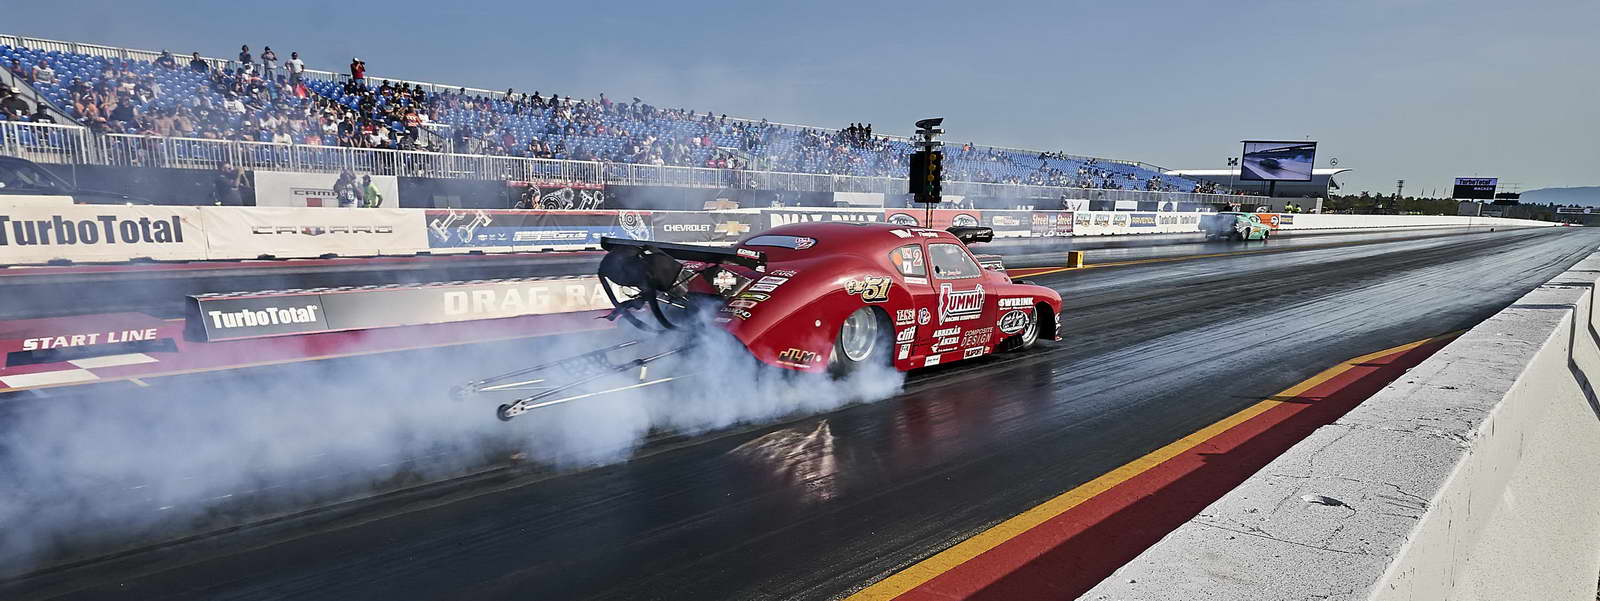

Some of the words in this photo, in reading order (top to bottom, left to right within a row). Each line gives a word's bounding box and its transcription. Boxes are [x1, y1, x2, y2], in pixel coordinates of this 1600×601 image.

[1032, 214, 1049, 225] Street
[1057, 214, 1073, 225] Street
[0, 215, 183, 246] TurboTotal
[663, 224, 711, 232] CHEVROLET
[444, 285, 549, 315] DRAG
[938, 283, 985, 325] SUMMIT
[209, 306, 317, 329] TurboTotal
[896, 326, 916, 341] cliff
[965, 327, 994, 337] COMPOSITE
[22, 333, 100, 351] START
[107, 329, 157, 344] LINE
[960, 333, 993, 347] DESIGN
[779, 348, 816, 362] JLM
